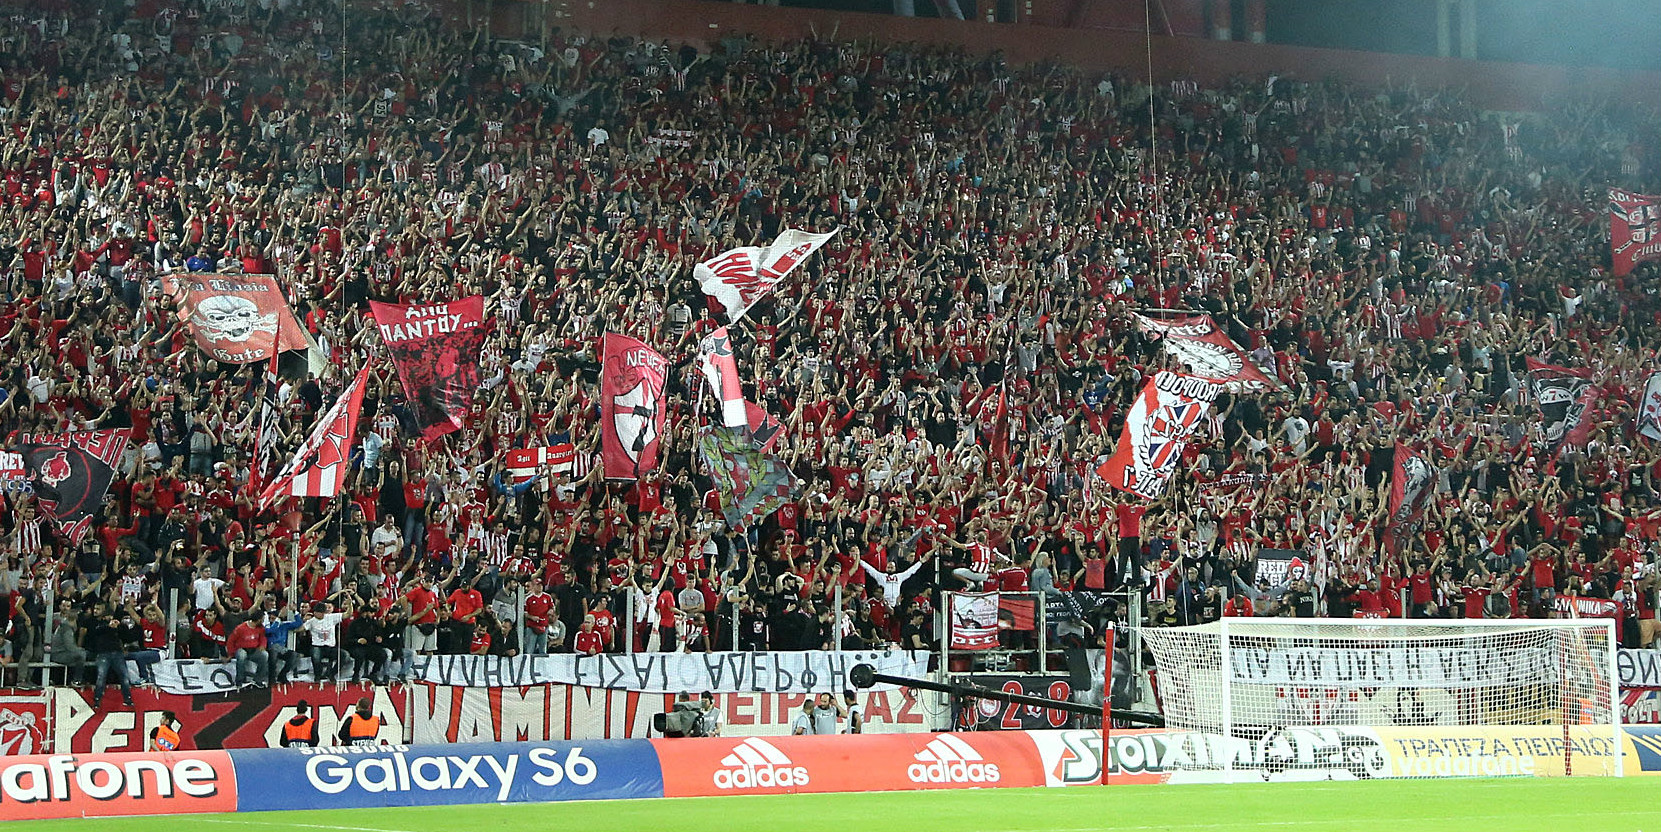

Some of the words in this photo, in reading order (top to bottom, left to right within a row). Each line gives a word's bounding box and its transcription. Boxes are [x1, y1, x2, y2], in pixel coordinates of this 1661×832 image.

[213, 348, 265, 362] Gate
[299, 743, 411, 755] SAMSUNG
[1393, 738, 1513, 758] ΤΡΑΠΕΖΑ
[305, 751, 519, 801] Galaxy
[529, 747, 597, 786] S6
[713, 763, 810, 789] adidas
[907, 757, 1000, 784] adidas
[1395, 750, 1536, 777] vodafone
